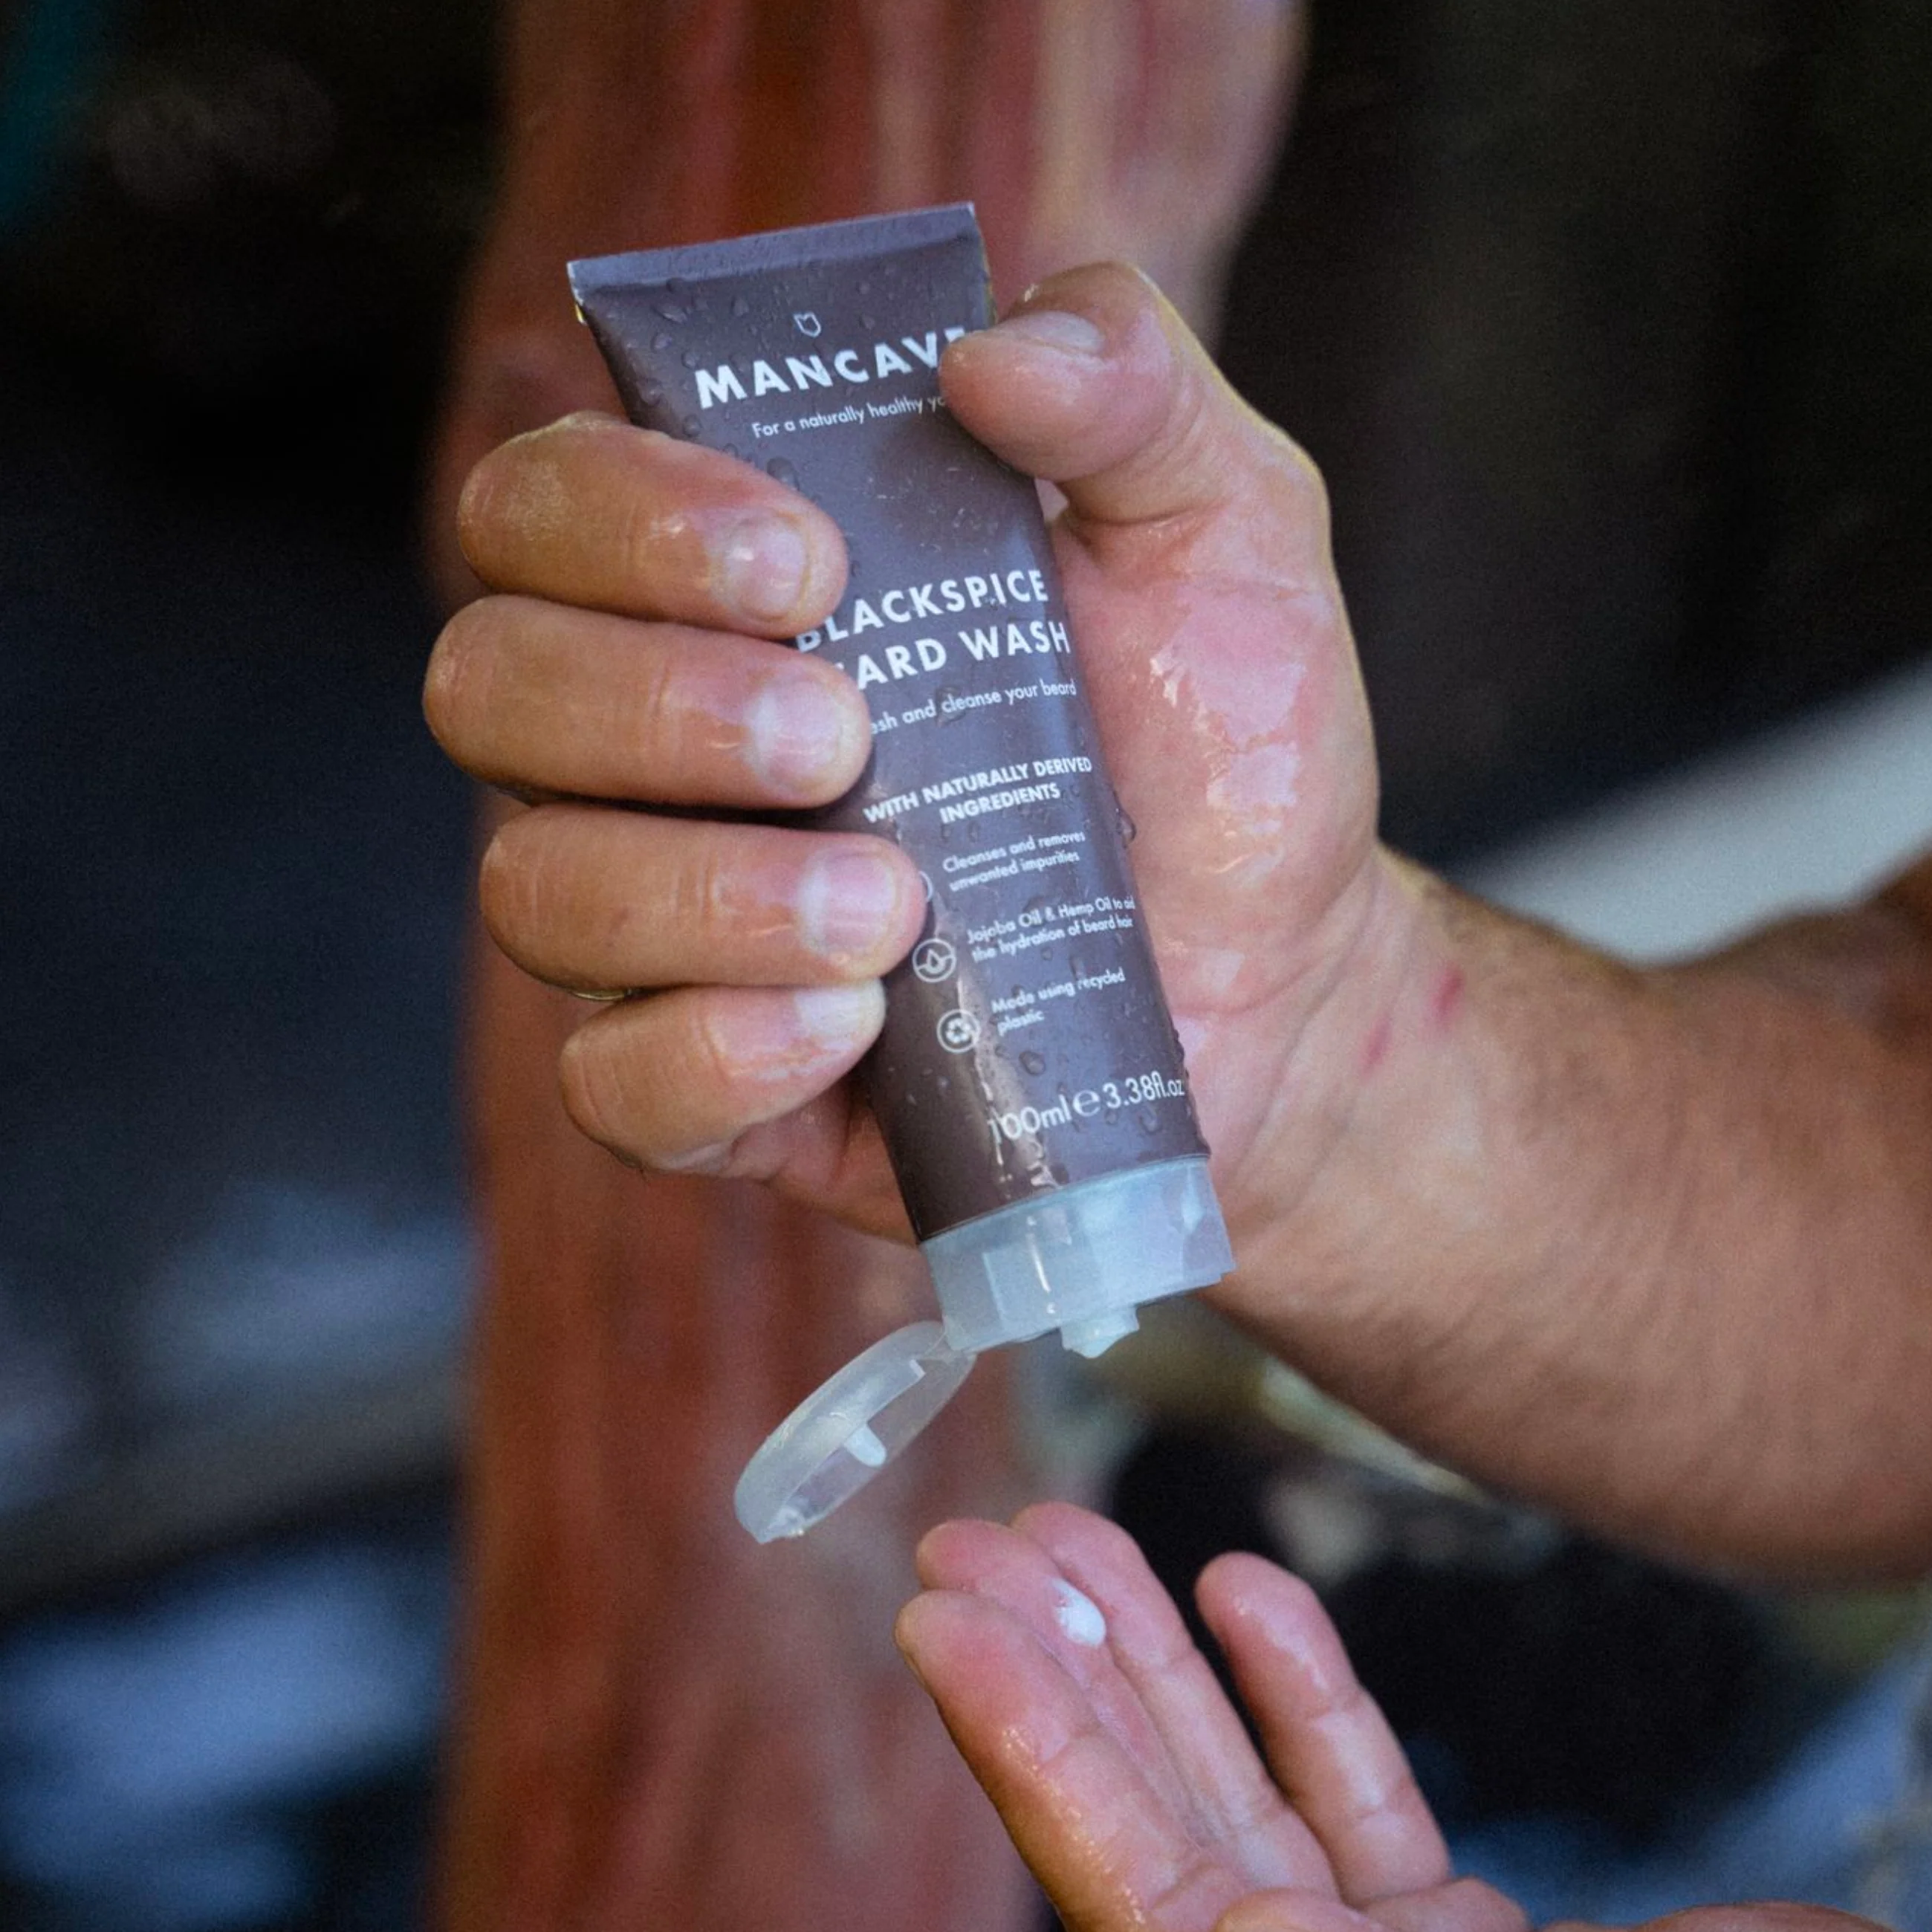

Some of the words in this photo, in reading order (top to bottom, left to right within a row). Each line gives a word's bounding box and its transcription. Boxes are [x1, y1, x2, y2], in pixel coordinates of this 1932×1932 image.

[695, 327, 965, 409] MANCAV
[752, 422, 779, 438] For
[785, 419, 796, 432] a
[800, 403, 864, 429] naturally
[867, 396, 923, 419] healthy
[927, 396, 945, 413] yo
[796, 570, 1048, 653] BLACKSPICE
[834, 638, 947, 690] ARD
[958, 620, 1071, 661] WASH
[903, 699, 936, 725] and
[941, 690, 1002, 715] cleanse
[1005, 684, 1038, 706] your
[1040, 678, 1077, 697] beard
[863, 793, 919, 824] WITH
[921, 763, 1031, 805] NATURALLY
[1033, 756, 1092, 777] DERIVED
[939, 783, 1061, 825] INGREDIENTS
[942, 848, 1007, 873] Cleanses
[1009, 837, 1036, 856] and
[1037, 830, 1086, 849] removes
[948, 860, 1018, 892] unwanted
[1020, 849, 1080, 872] impurities
[967, 918, 1016, 944] Jojoba
[1018, 910, 1040, 928] Oil
[1045, 907, 1057, 921] &
[1058, 901, 1095, 918] Hemp
[1095, 896, 1112, 912] Oil
[1112, 897, 1123, 910] to
[970, 946, 997, 962] the
[998, 927, 1065, 956] hydration
[1068, 920, 1080, 936] of
[1081, 915, 1115, 934] beard
[1115, 912, 1133, 928] hair
[991, 991, 1035, 1014] Made
[1038, 979, 1076, 999] using
[1077, 967, 1126, 991] recycled
[996, 1008, 1045, 1035] plastic
[988, 1095, 1072, 1144] 100ml
